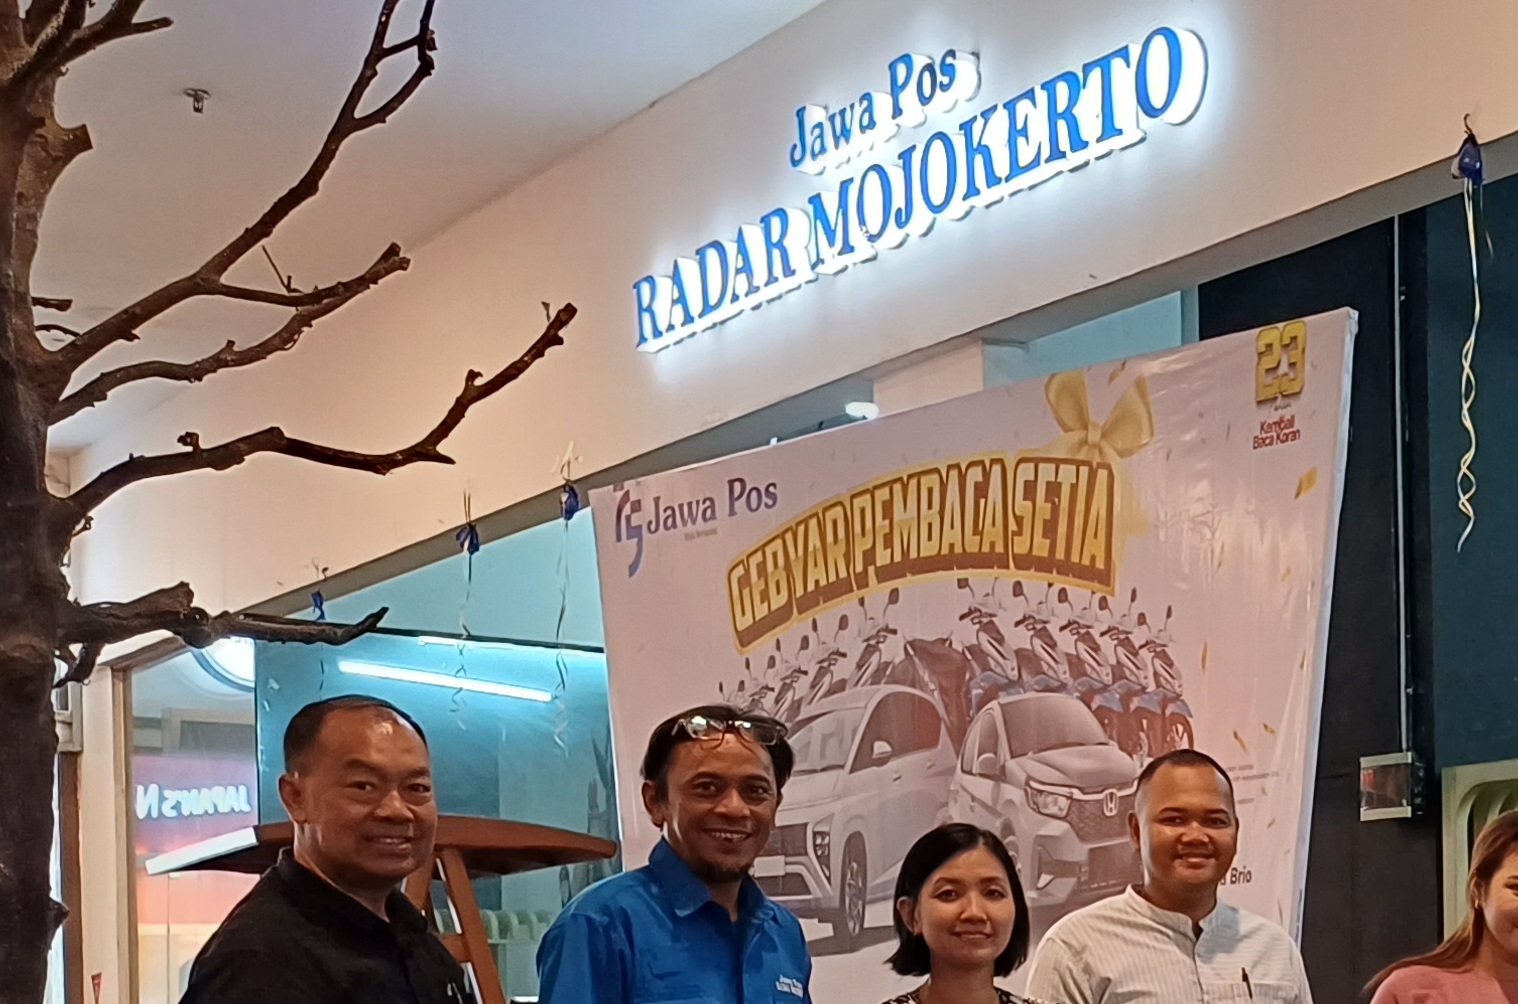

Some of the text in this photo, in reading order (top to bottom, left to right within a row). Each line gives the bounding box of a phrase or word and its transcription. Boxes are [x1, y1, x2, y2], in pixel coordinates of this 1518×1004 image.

[789, 49, 958, 168] Jawa Pos
[632, 26, 1184, 348] RADAR MOJOKERTO
[1256, 320, 1306, 403] 23
[1252, 428, 1301, 450] Baca Koran
[647, 476, 779, 535] Jawa Pos
[728, 459, 1112, 638] GEBYAR PEMBACA SETIA
[1230, 865, 1252, 885] Brio
